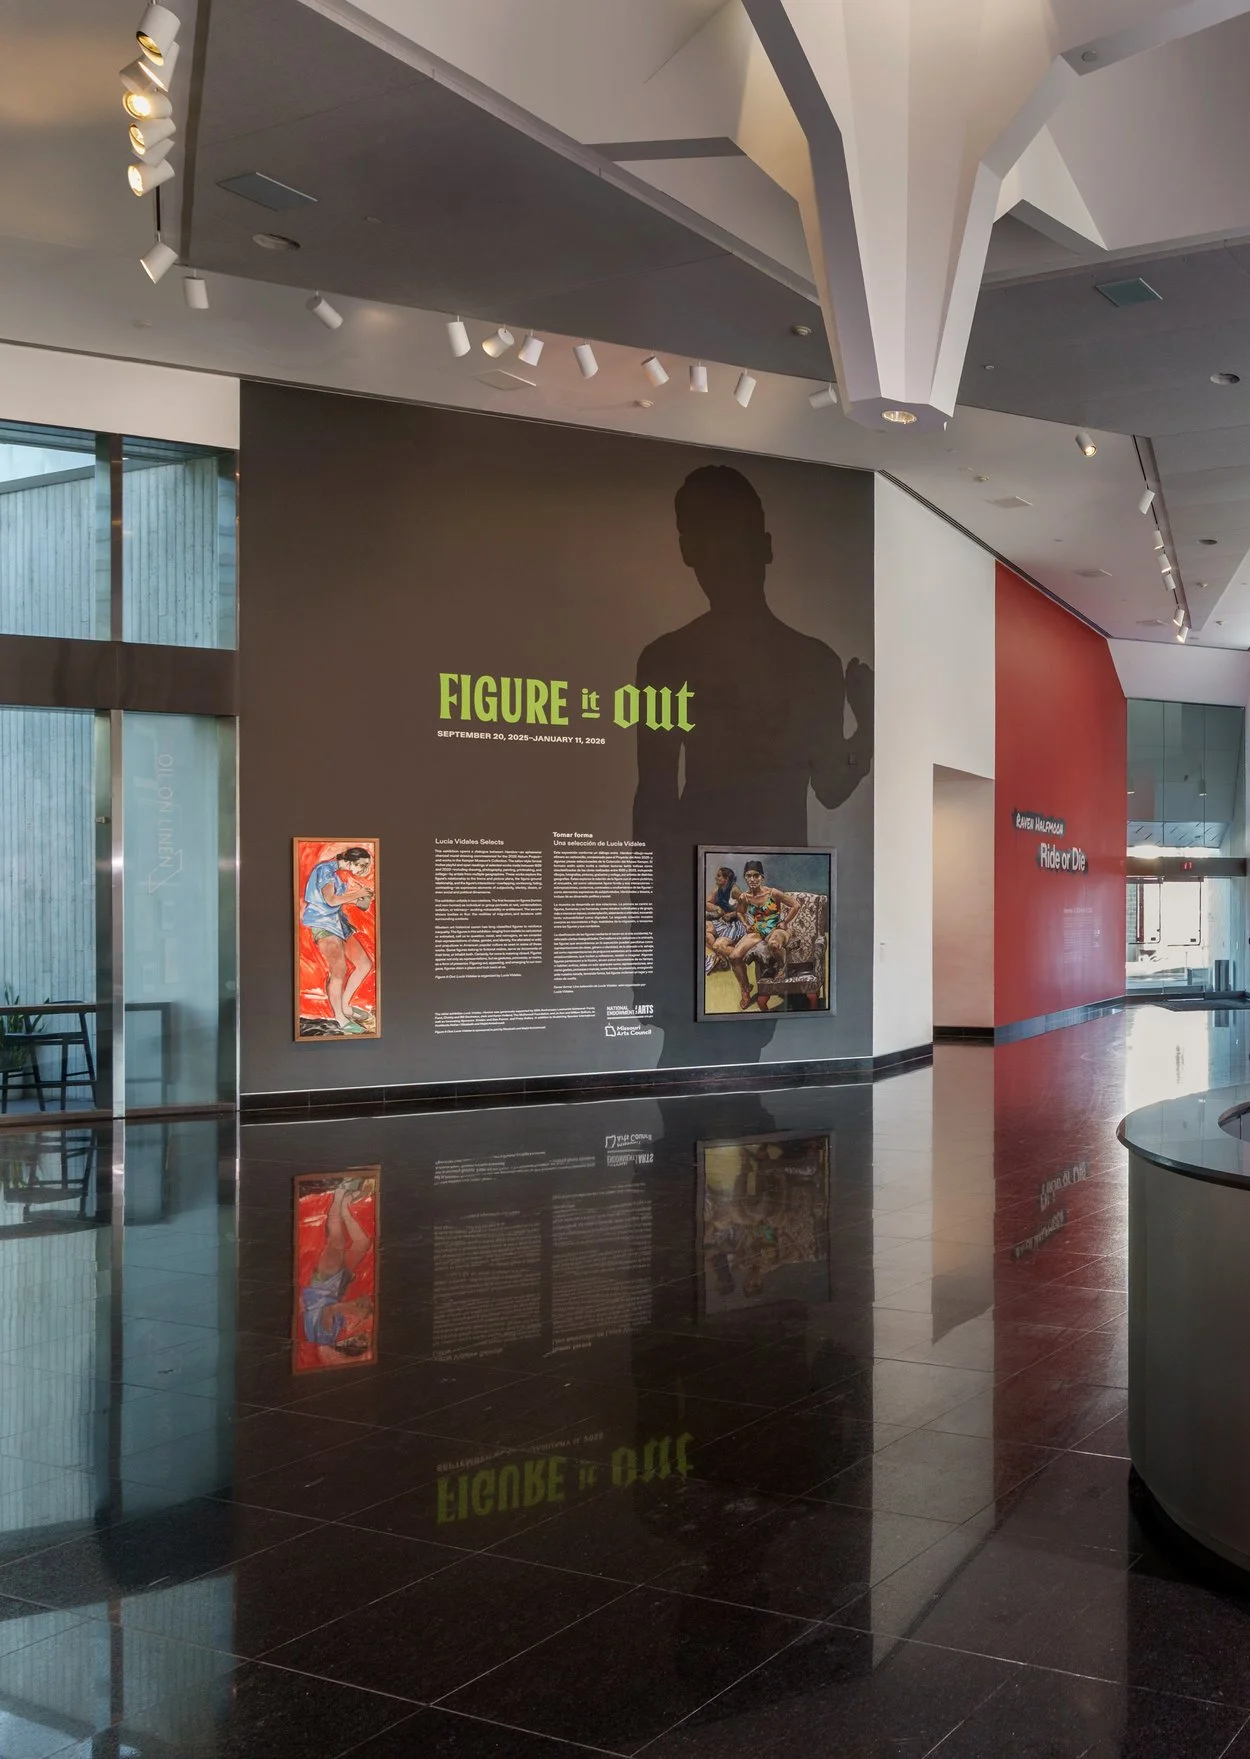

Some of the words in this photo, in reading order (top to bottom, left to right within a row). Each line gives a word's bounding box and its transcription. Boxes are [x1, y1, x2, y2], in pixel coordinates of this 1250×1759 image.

[439, 673, 569, 726] FIGURE
[581, 688, 600, 712] it
[613, 680, 696, 732] out
[438, 730, 491, 739] SEPTEMBER
[493, 733, 507, 741] 20,
[575, 737, 584, 745] 11,
[585, 737, 606, 745] 2026
[157, 753, 173, 778] OIL
[157, 787, 173, 812] ON
[157, 820, 173, 867] LINEN
[1040, 843, 1061, 869] Ride
[1061, 853, 1071, 870] or
[1072, 847, 1086, 872] Die
[638, 1004, 654, 1015] ARTS
